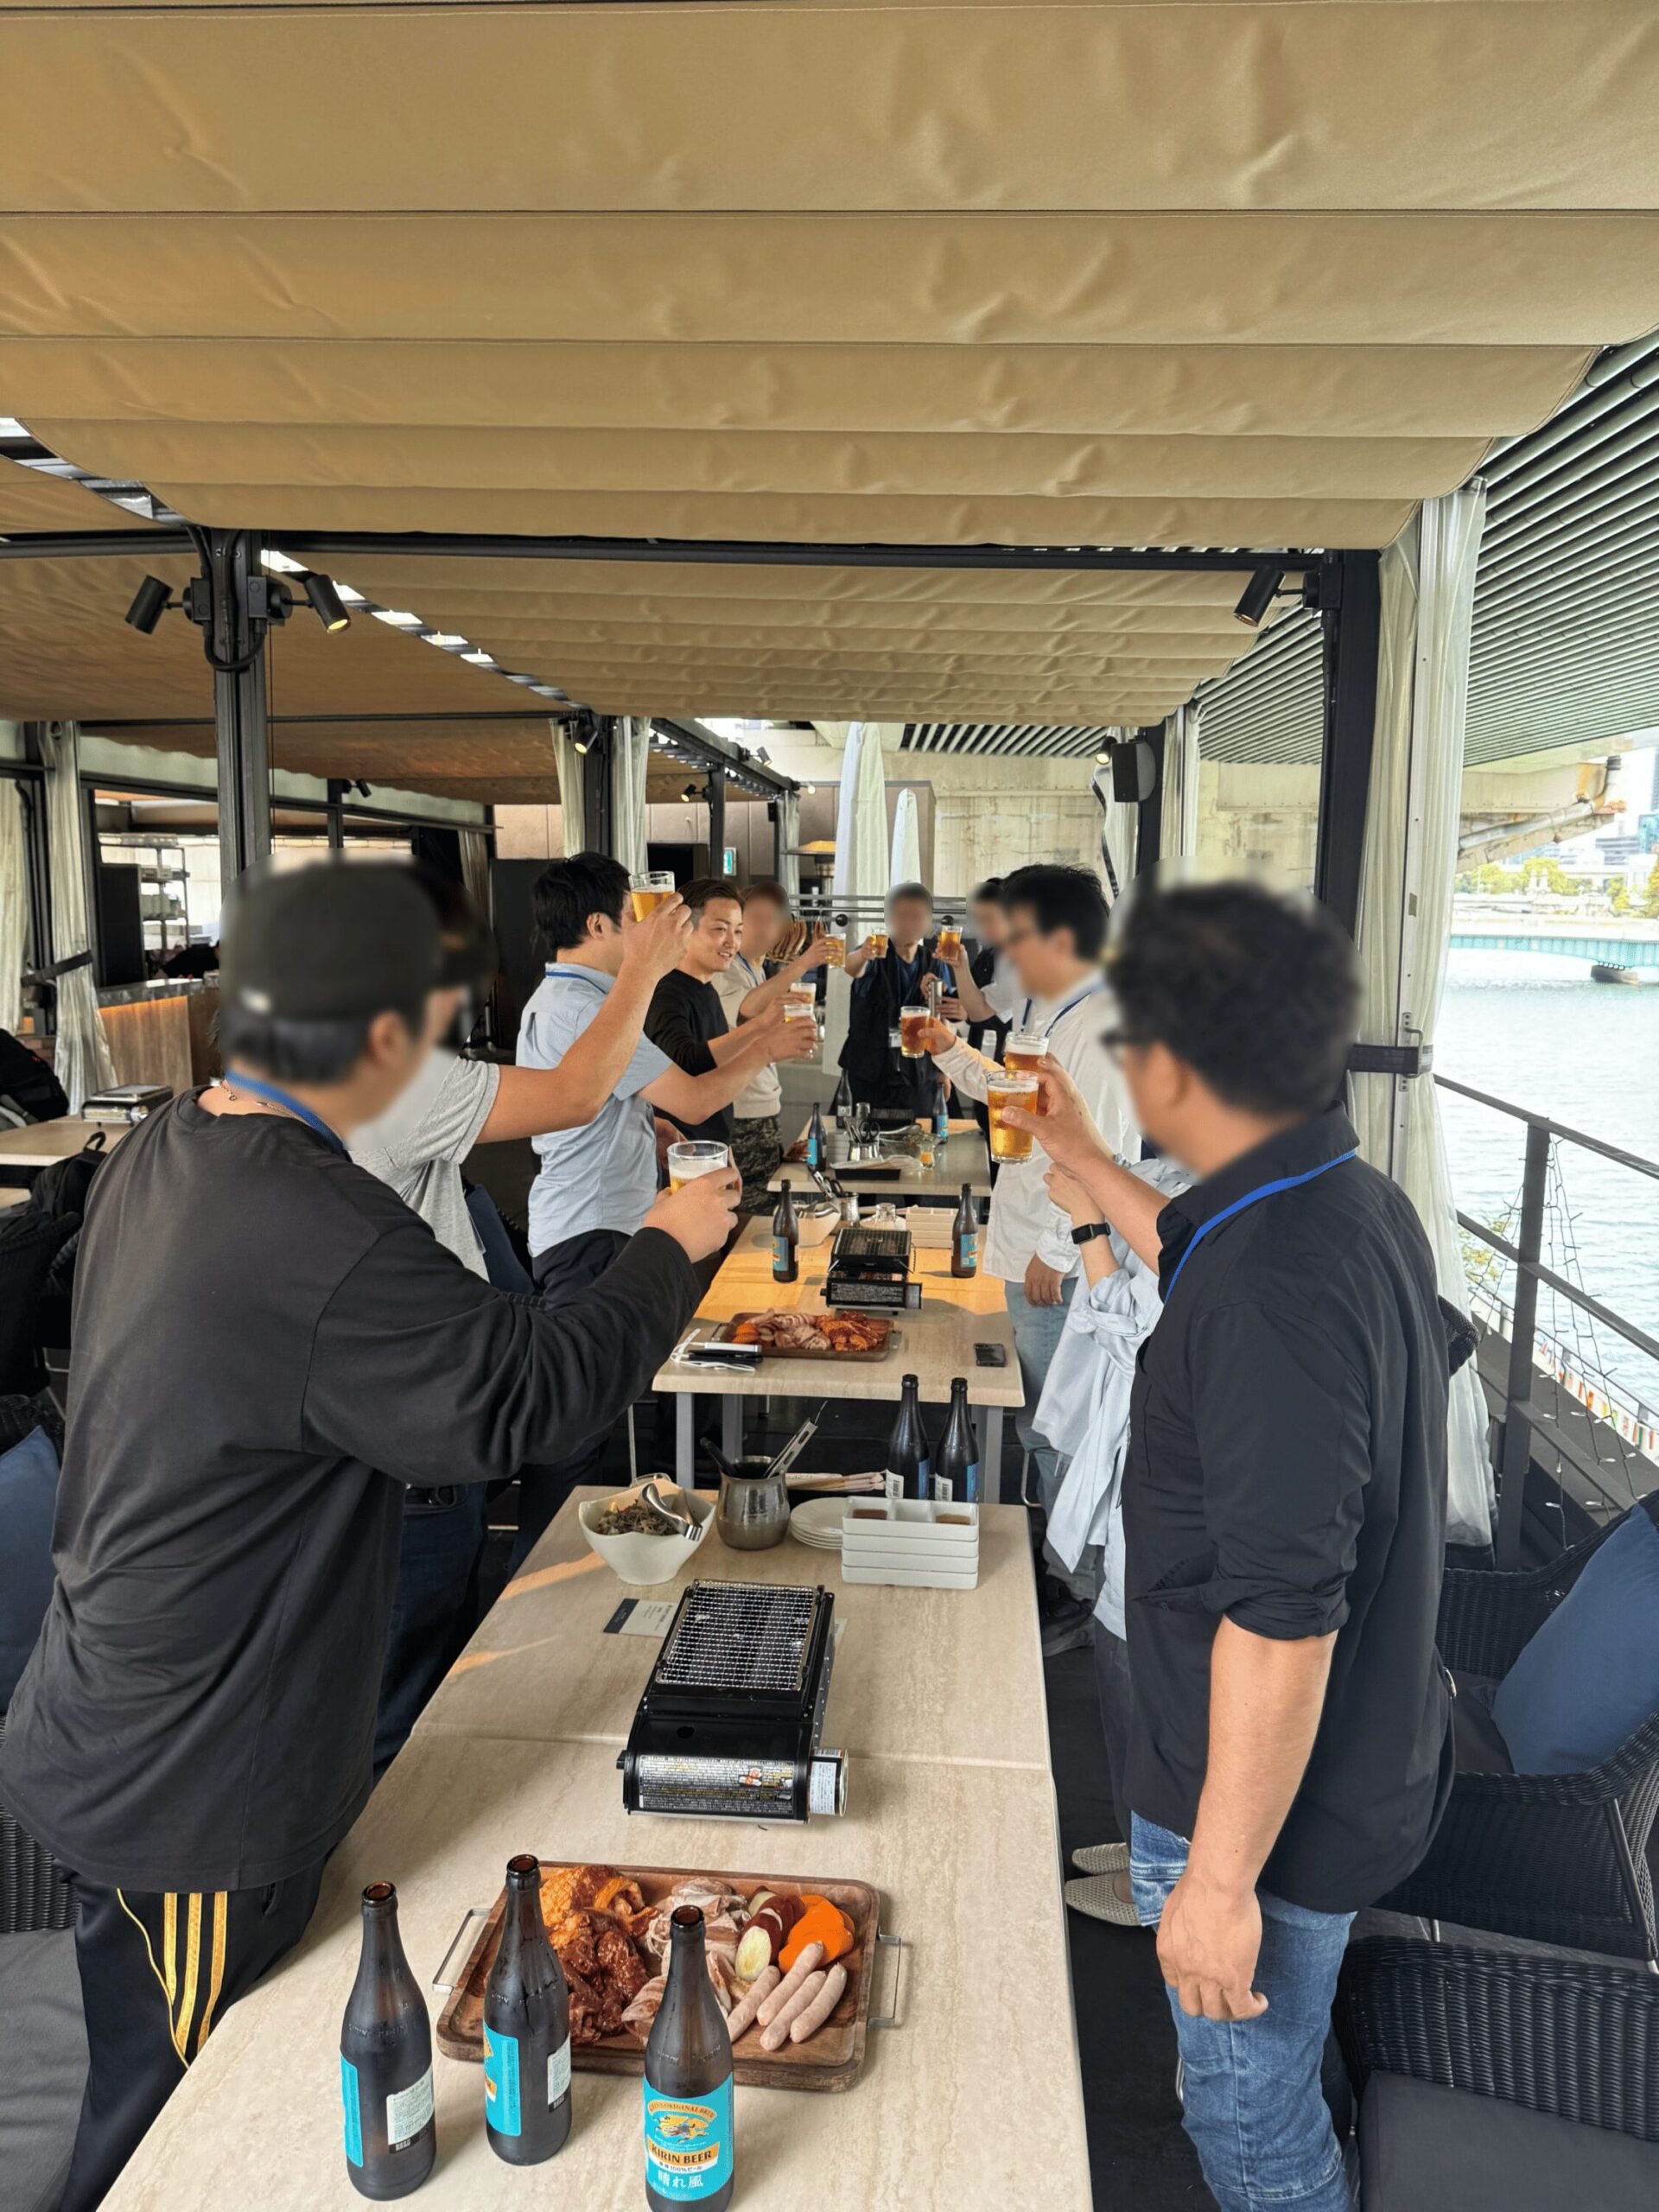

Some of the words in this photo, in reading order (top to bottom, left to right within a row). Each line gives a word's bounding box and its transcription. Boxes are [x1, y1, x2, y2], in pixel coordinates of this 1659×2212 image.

[652, 2144, 680, 2164] KIRIN
[683, 2150, 712, 2164] BEER
[659, 2161, 703, 2172] 100%ビール
